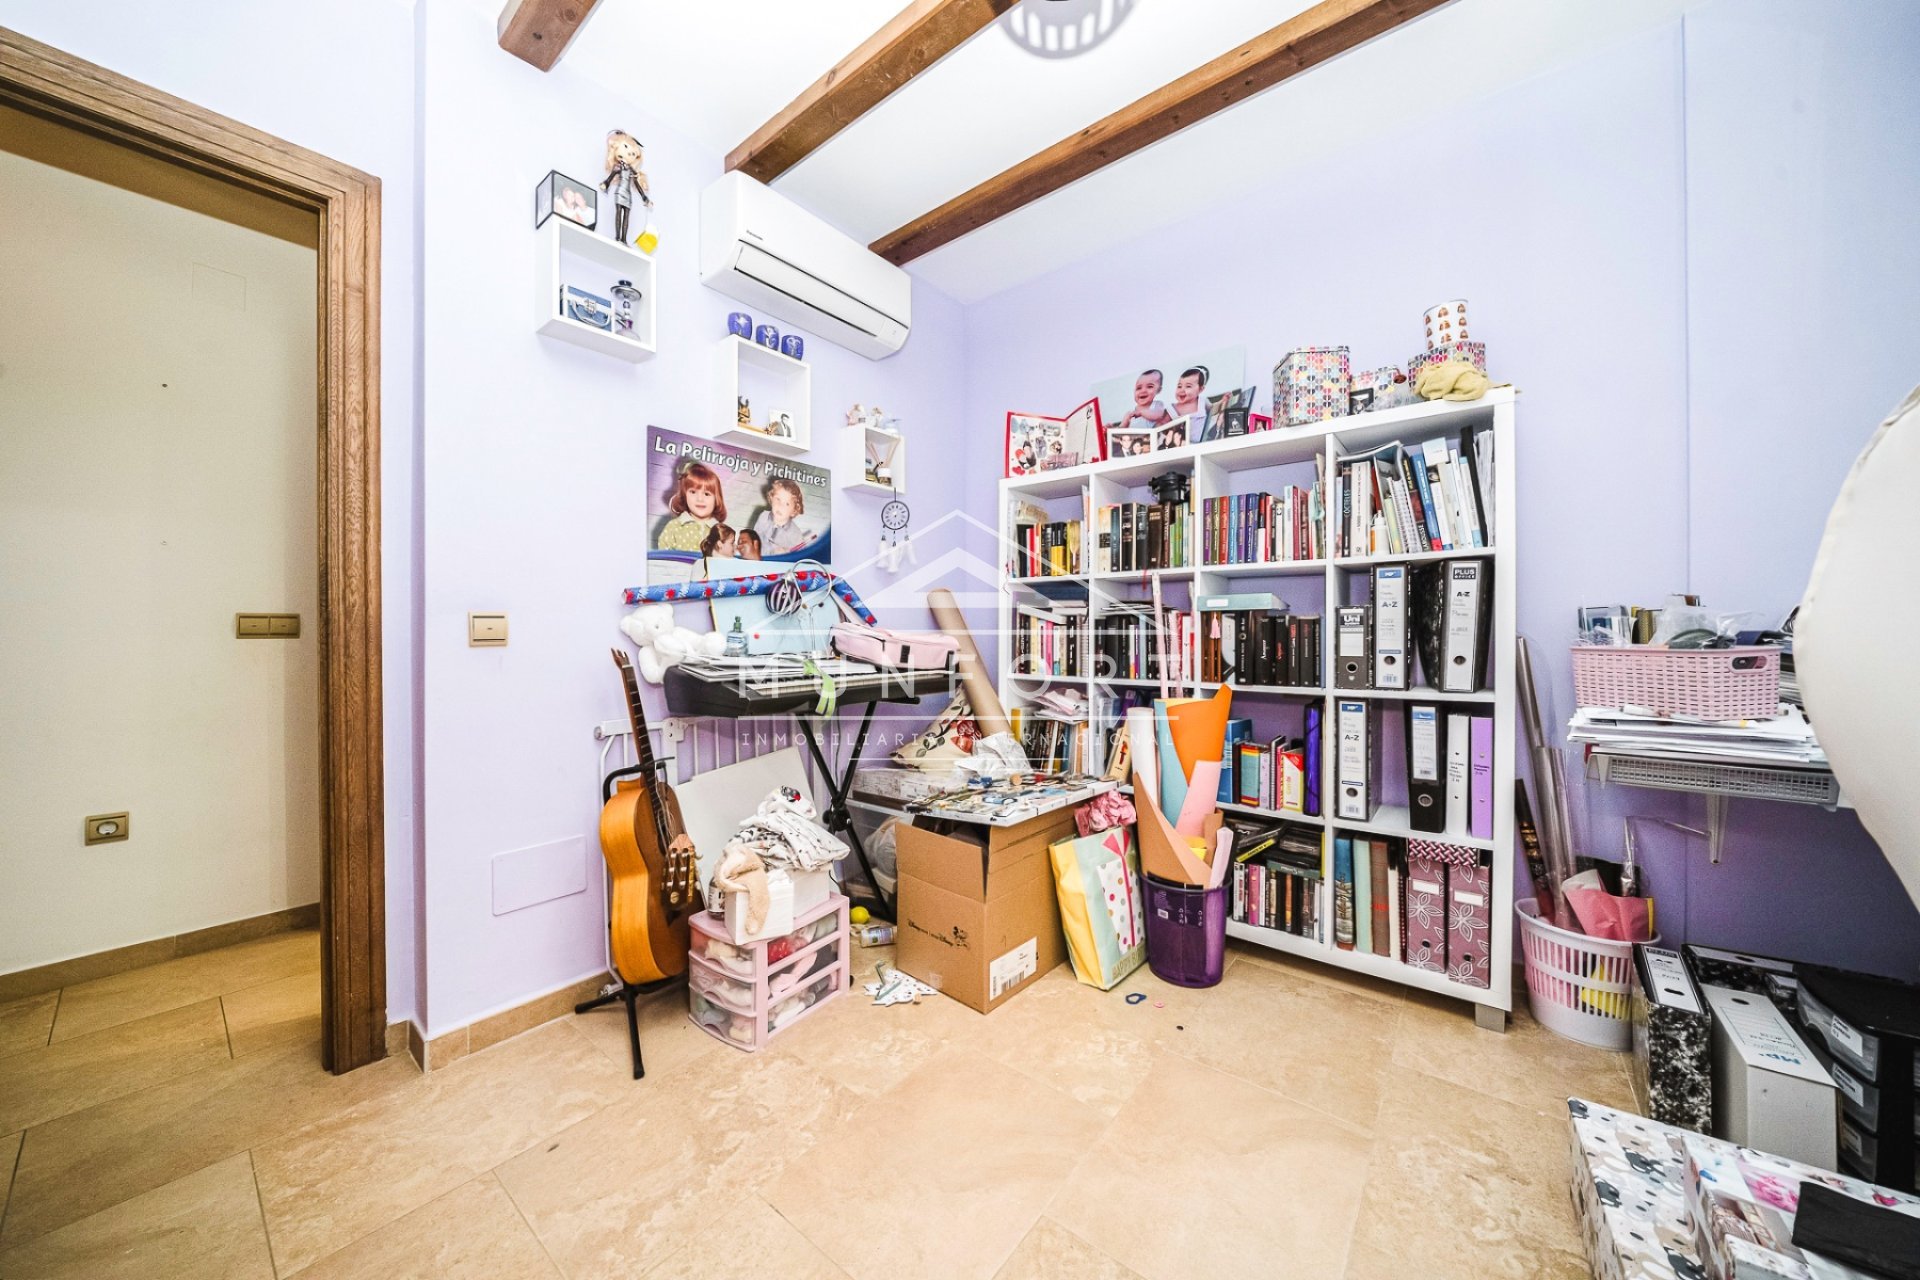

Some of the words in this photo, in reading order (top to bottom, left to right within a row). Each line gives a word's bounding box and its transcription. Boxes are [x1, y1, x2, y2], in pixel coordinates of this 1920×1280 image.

[654, 435, 677, 455] La
[680, 441, 749, 473] Pelirroja
[750, 461, 762, 477] y
[764, 461, 827, 487] Pichitines
[1343, 614, 1361, 622] Uni
